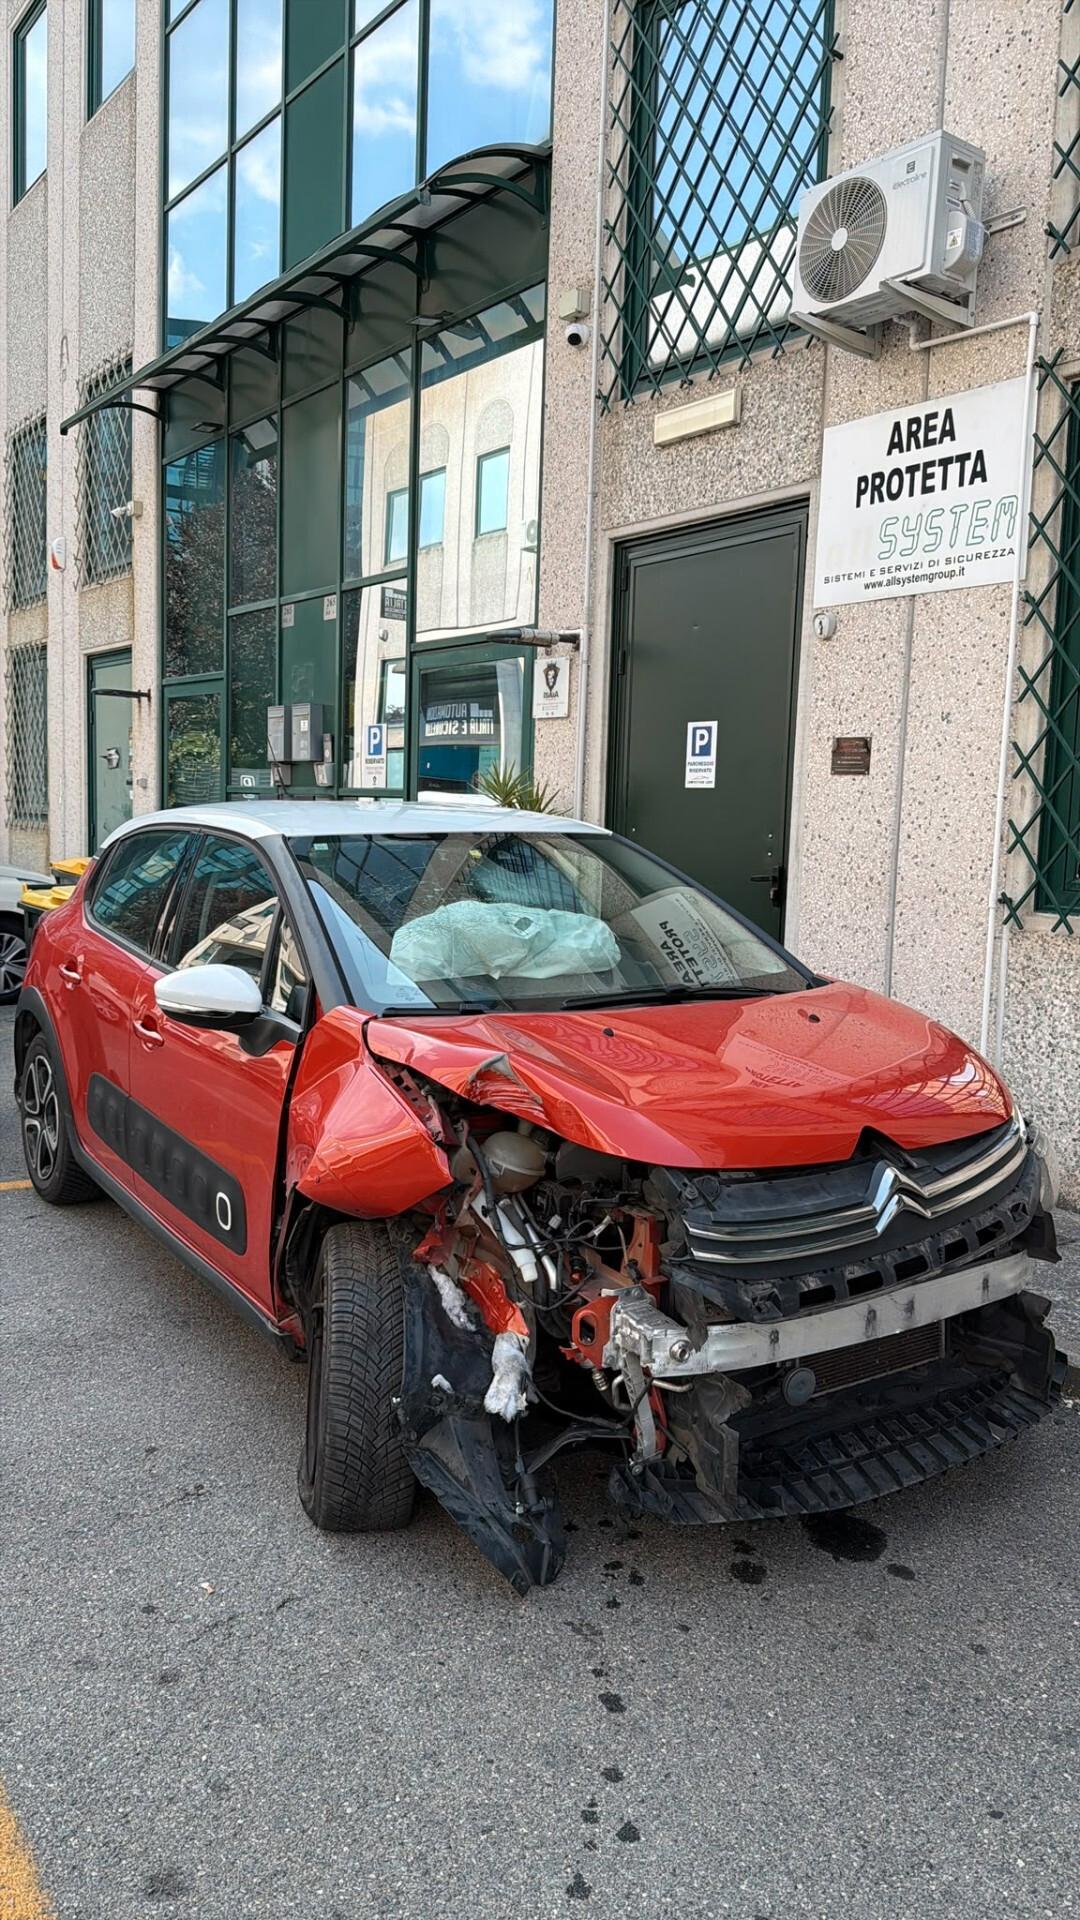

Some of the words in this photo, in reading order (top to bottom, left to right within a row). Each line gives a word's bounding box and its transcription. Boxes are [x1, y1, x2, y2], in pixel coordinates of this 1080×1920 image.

[886, 408, 956, 456] AREA
[856, 449, 987, 508] PROTETTA
[878, 495, 1019, 560] SYSTEM
[824, 571, 866, 584] SISTEMI
[869, 569, 876, 577] E
[880, 561, 923, 575] SERVIZI
[928, 559, 940, 568] DI
[945, 547, 1015, 566] SICUREZZA
[864, 567, 965, 590] www.allsystemgroup.it
[370, 727, 381, 754] P
[695, 728, 709, 754] P
